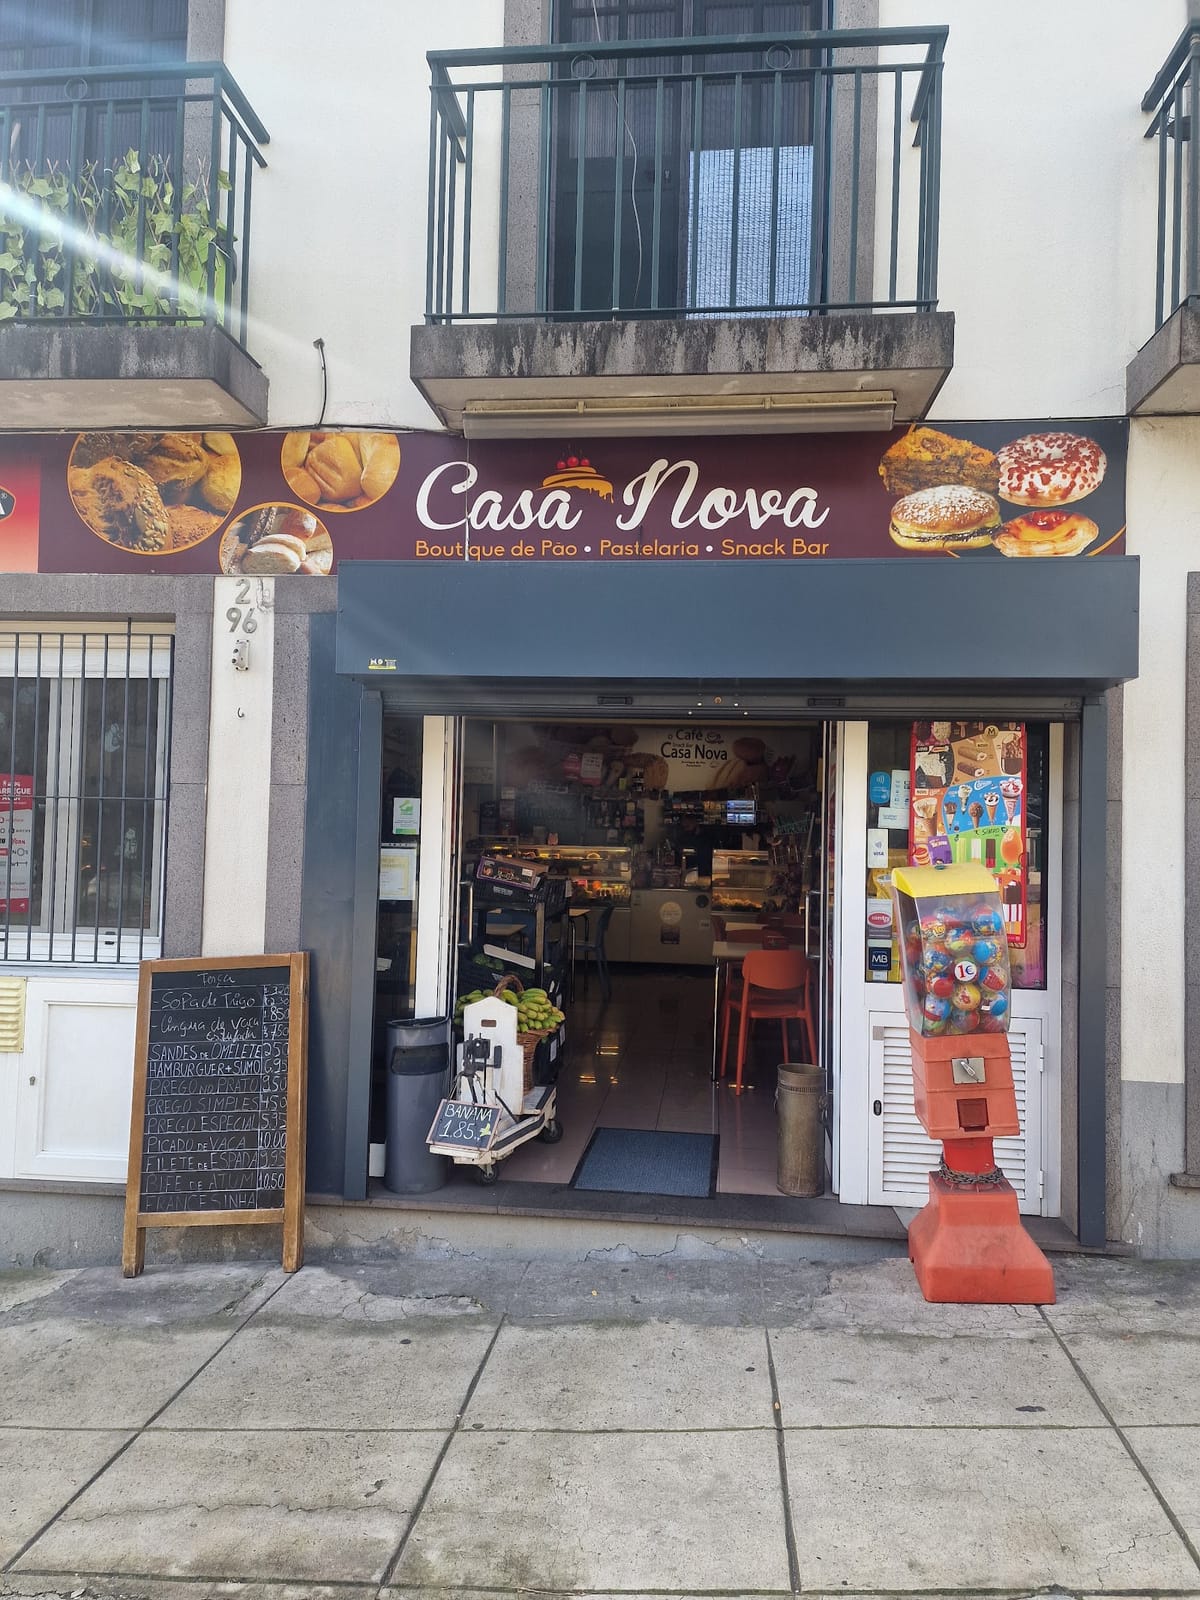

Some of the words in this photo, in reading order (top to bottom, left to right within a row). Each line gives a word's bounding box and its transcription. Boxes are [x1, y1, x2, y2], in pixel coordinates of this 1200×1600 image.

[415, 461, 583, 531] Casa
[616, 458, 830, 531] Nova
[415, 541, 505, 561] Boutique
[511, 540, 535, 557] de
[541, 540, 577, 557] Pão
[600, 540, 699, 556] Pastelaria
[721, 538, 785, 556] Snack
[792, 539, 829, 555] Bar
[235, 579, 251, 604] 2
[226, 607, 258, 633] 96
[675, 729, 703, 741] Café
[660, 741, 691, 759] Casa
[695, 744, 728, 760] Nova
[871, 954, 888, 963] MB
[149, 1044, 198, 1060] SANDES
[211, 1042, 261, 1059] OMELETE
[149, 1078, 198, 1097] PREGO
[216, 1077, 260, 1094] PRATO
[147, 1098, 192, 1115] PREGO
[198, 1096, 260, 1112] SIMPLES
[444, 1103, 493, 1121] BANANA
[147, 1117, 196, 1135] PREGO
[201, 1113, 257, 1132] ESPECIAL
[147, 1136, 195, 1153] PICADO
[210, 1136, 246, 1151] VACA
[145, 1155, 194, 1172] FILETE
[210, 1152, 258, 1170] ESPADA
[145, 1174, 182, 1193] BIFE
[208, 1172, 254, 1190] ATUM
